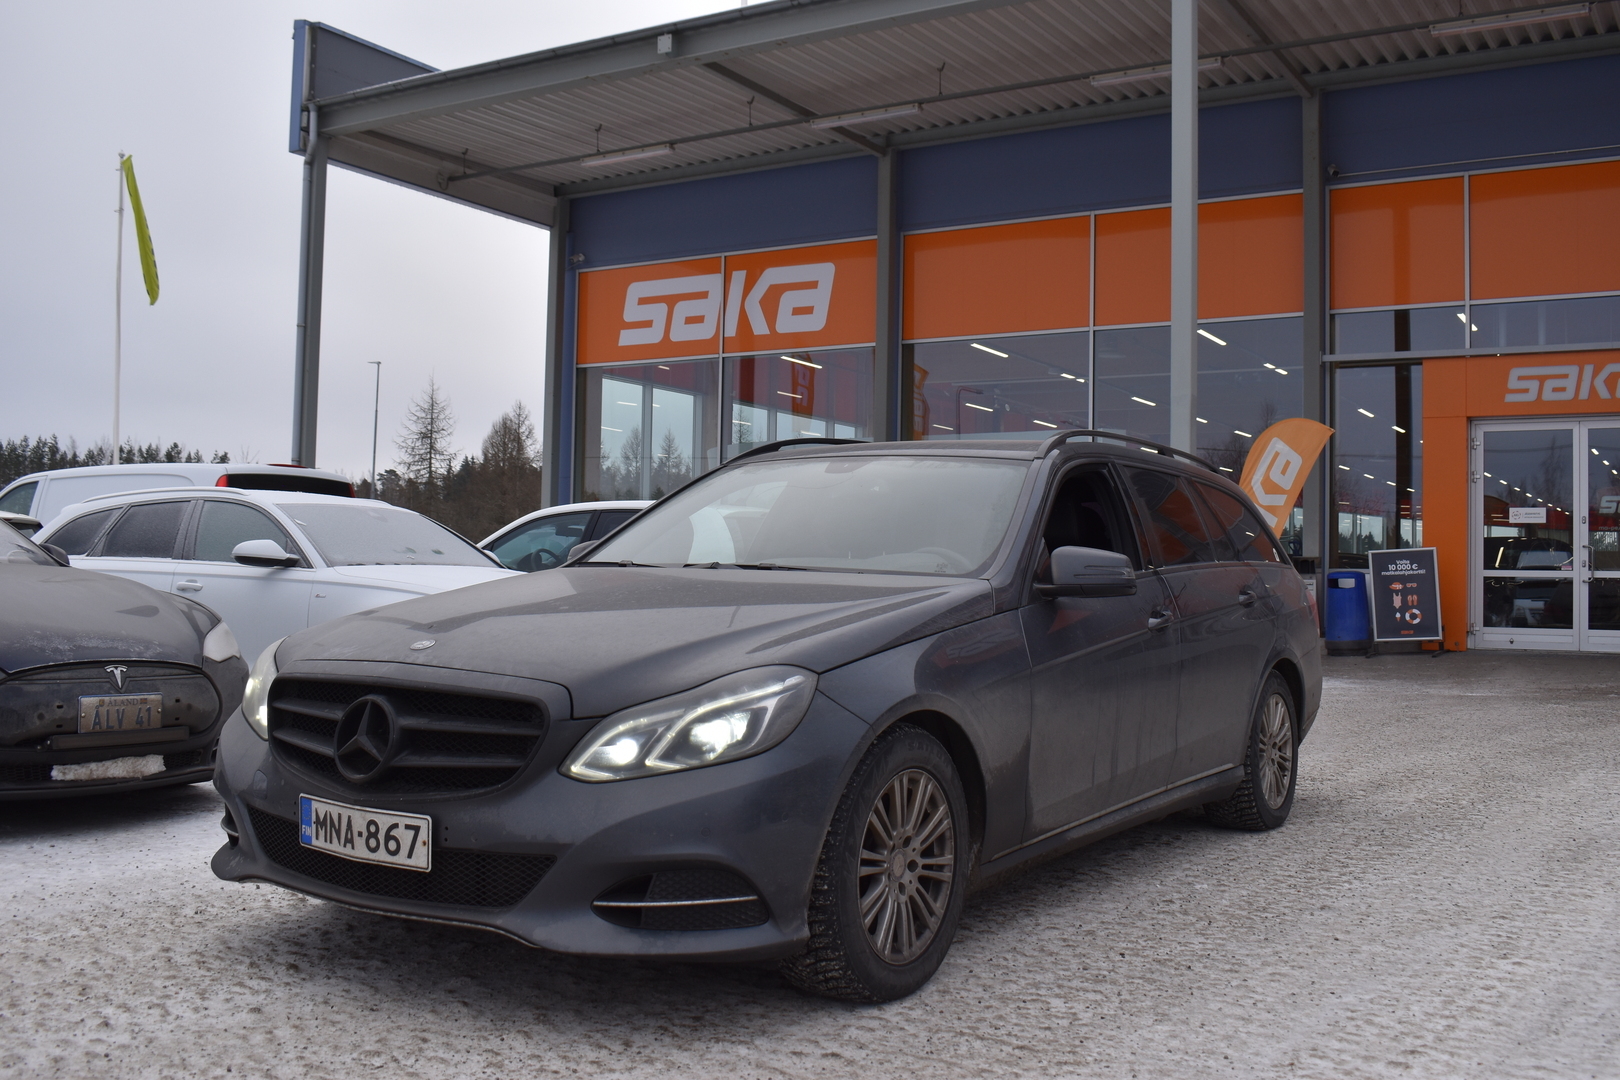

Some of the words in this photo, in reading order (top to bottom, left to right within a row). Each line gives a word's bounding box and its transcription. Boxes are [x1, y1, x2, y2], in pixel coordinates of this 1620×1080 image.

[107, 698, 139, 706] ÅLAND
[91, 705, 126, 730] ÅLV
[135, 706, 152, 727] 41
[302, 824, 312, 837] FIN
[315, 807, 422, 859] MNA-867
